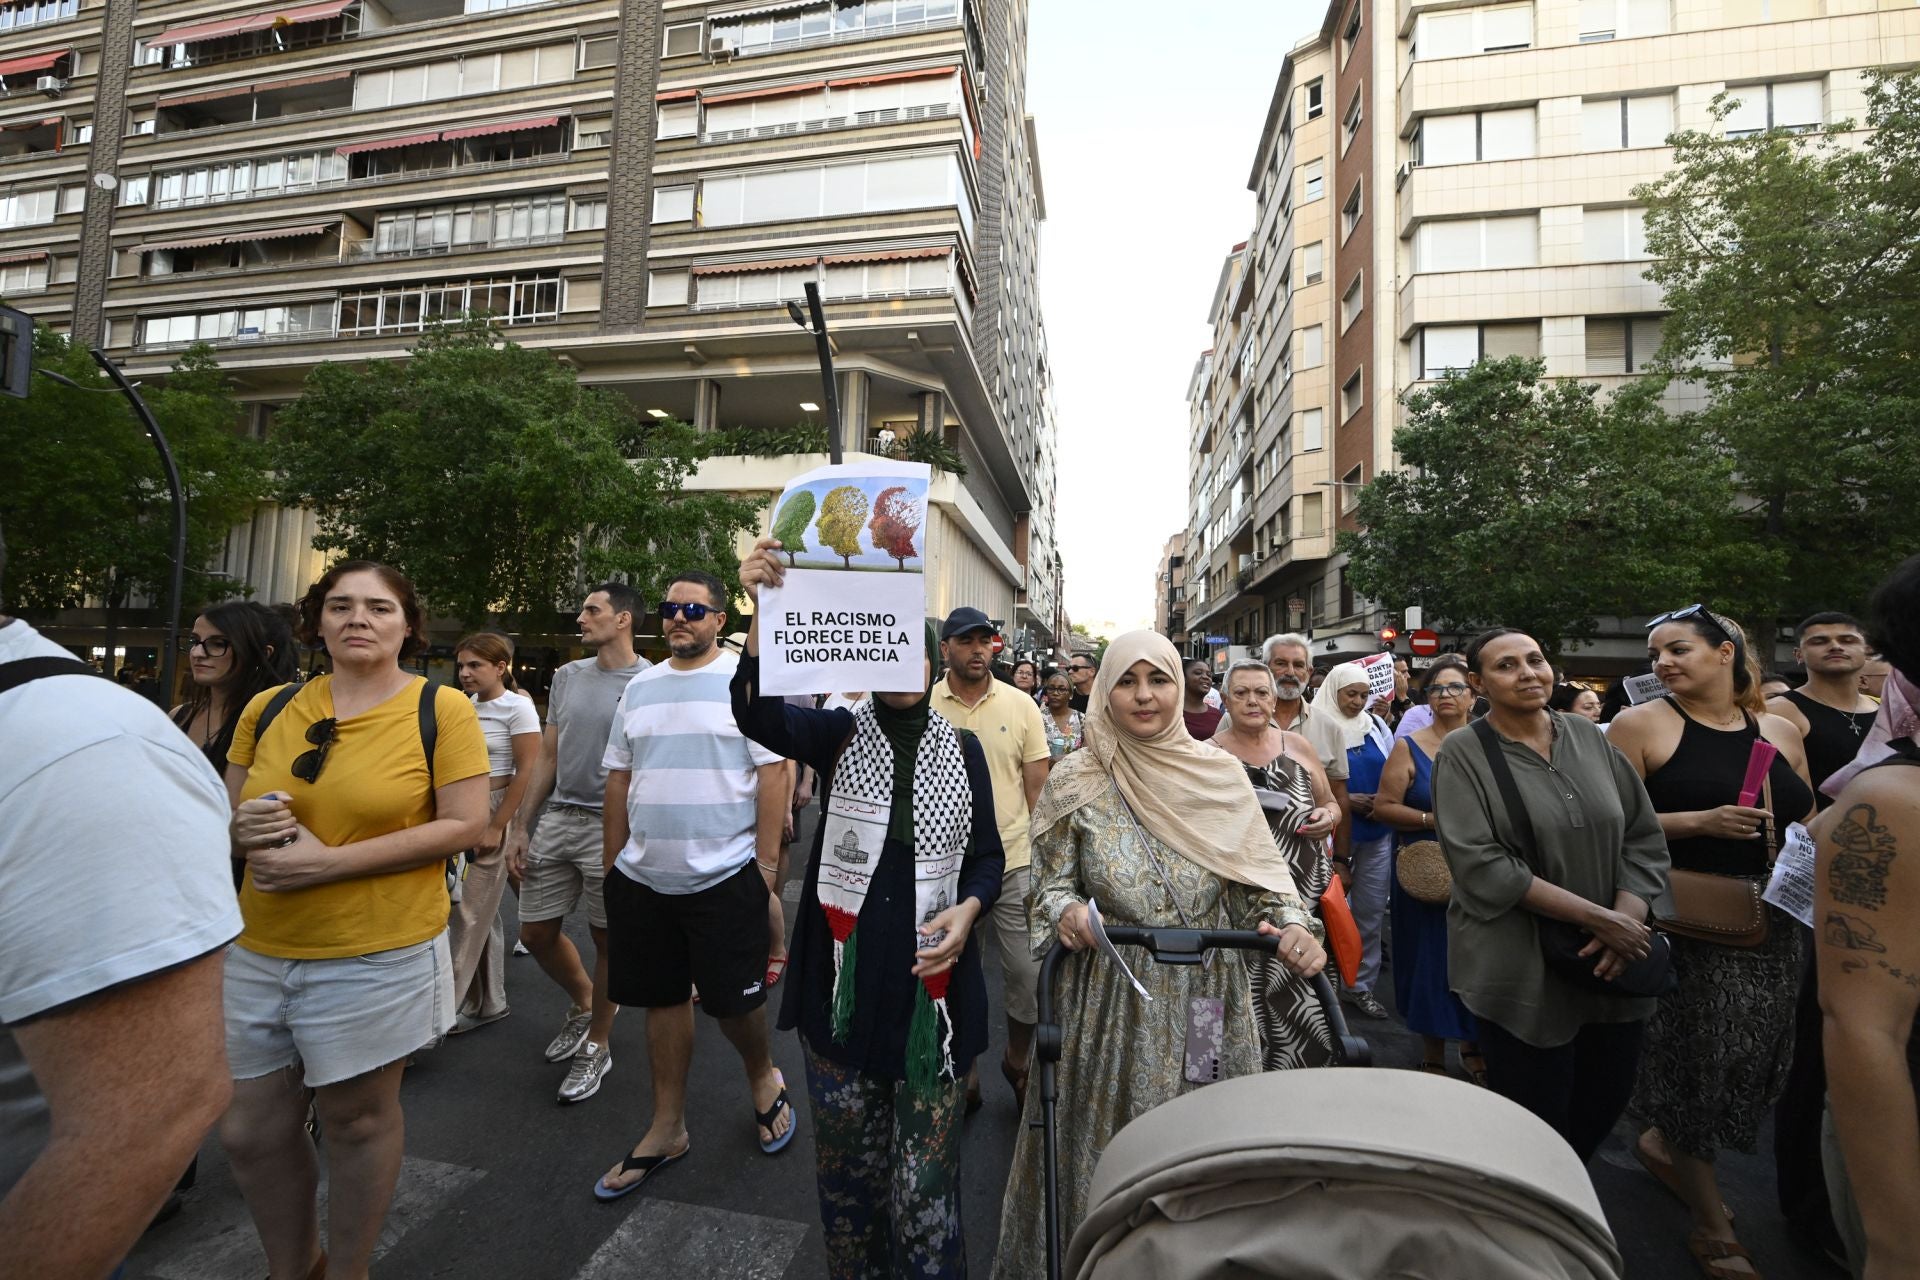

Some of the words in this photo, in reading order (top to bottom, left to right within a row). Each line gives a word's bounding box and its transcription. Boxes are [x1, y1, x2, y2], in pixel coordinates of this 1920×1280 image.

[786, 612, 806, 626] EL
[812, 612, 896, 627] RACISMO
[774, 630, 854, 645] FLORECE
[860, 630, 882, 644] DE
[888, 631, 910, 645] LA
[785, 648, 899, 663] IGNORANCIA
[1367, 663, 1392, 674] CONTRA
[1635, 678, 1659, 688] BASTA
[1639, 684, 1664, 694] RACIS
